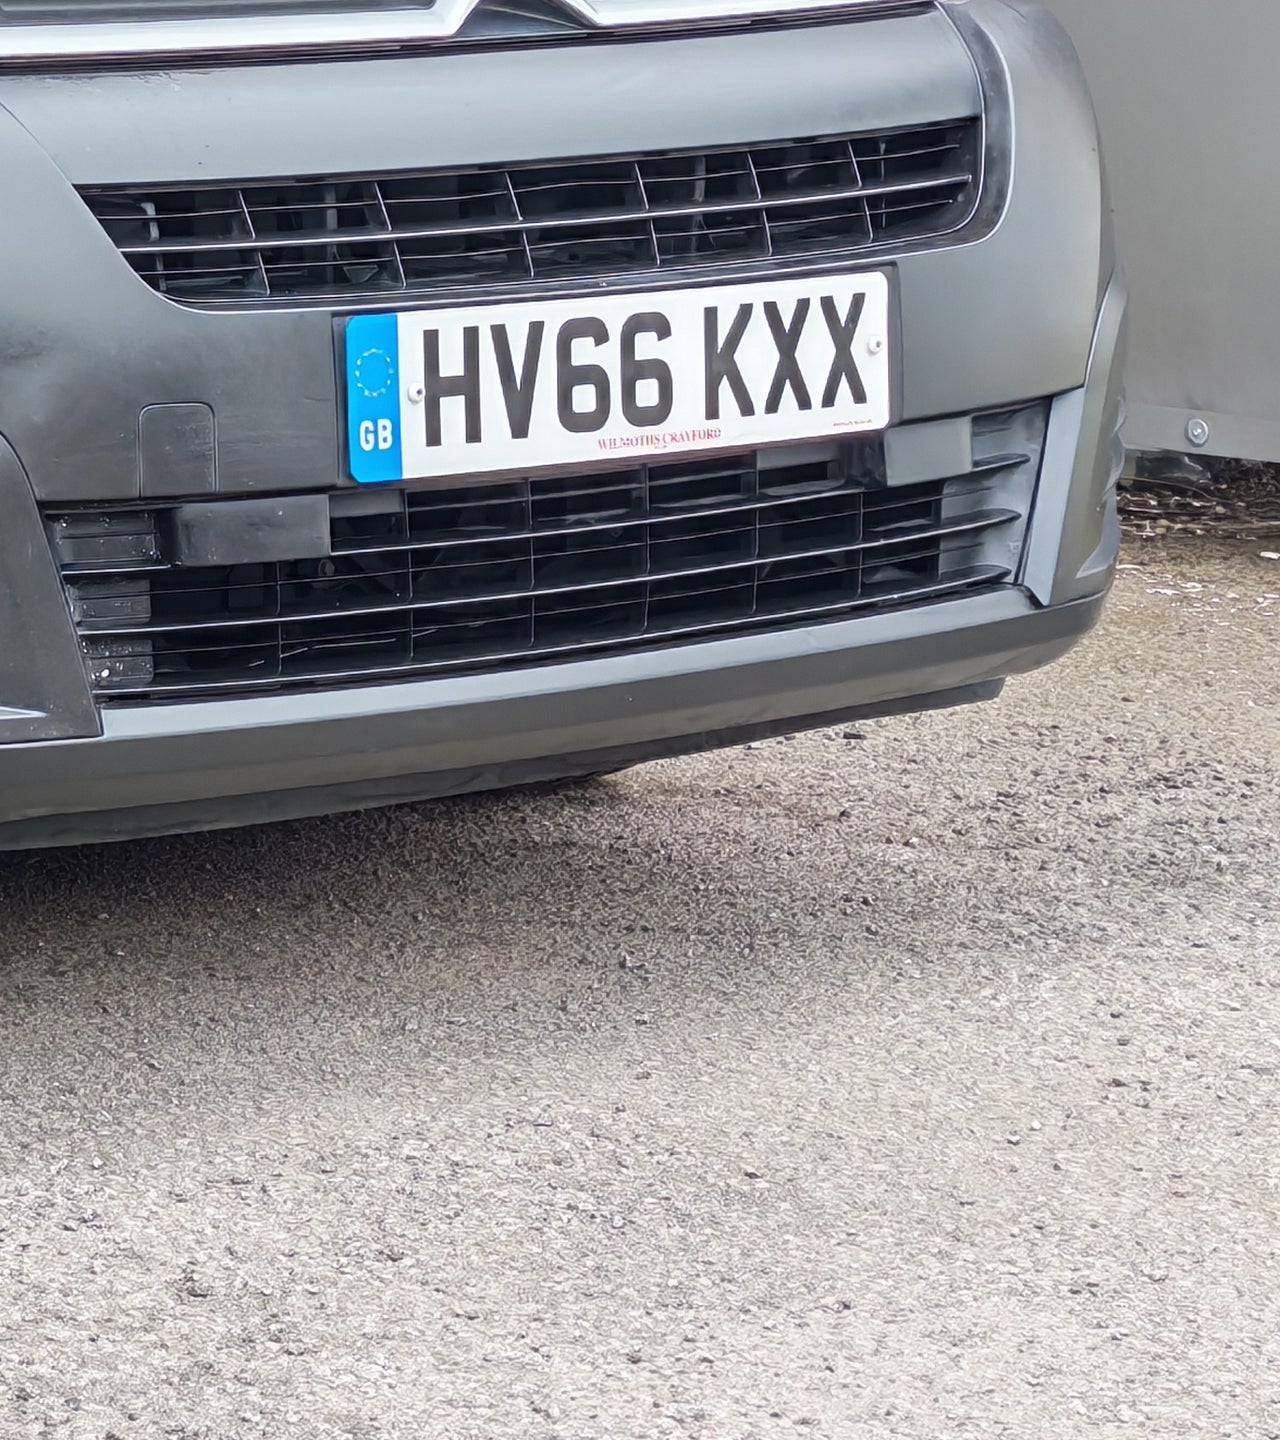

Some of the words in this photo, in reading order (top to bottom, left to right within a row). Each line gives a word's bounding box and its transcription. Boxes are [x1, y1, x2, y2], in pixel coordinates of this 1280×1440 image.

[423, 311, 673, 446] HV66
[704, 292, 868, 421] KXX
[358, 418, 393, 452] GB
[662, 428, 722, 445] CRAYFORD
